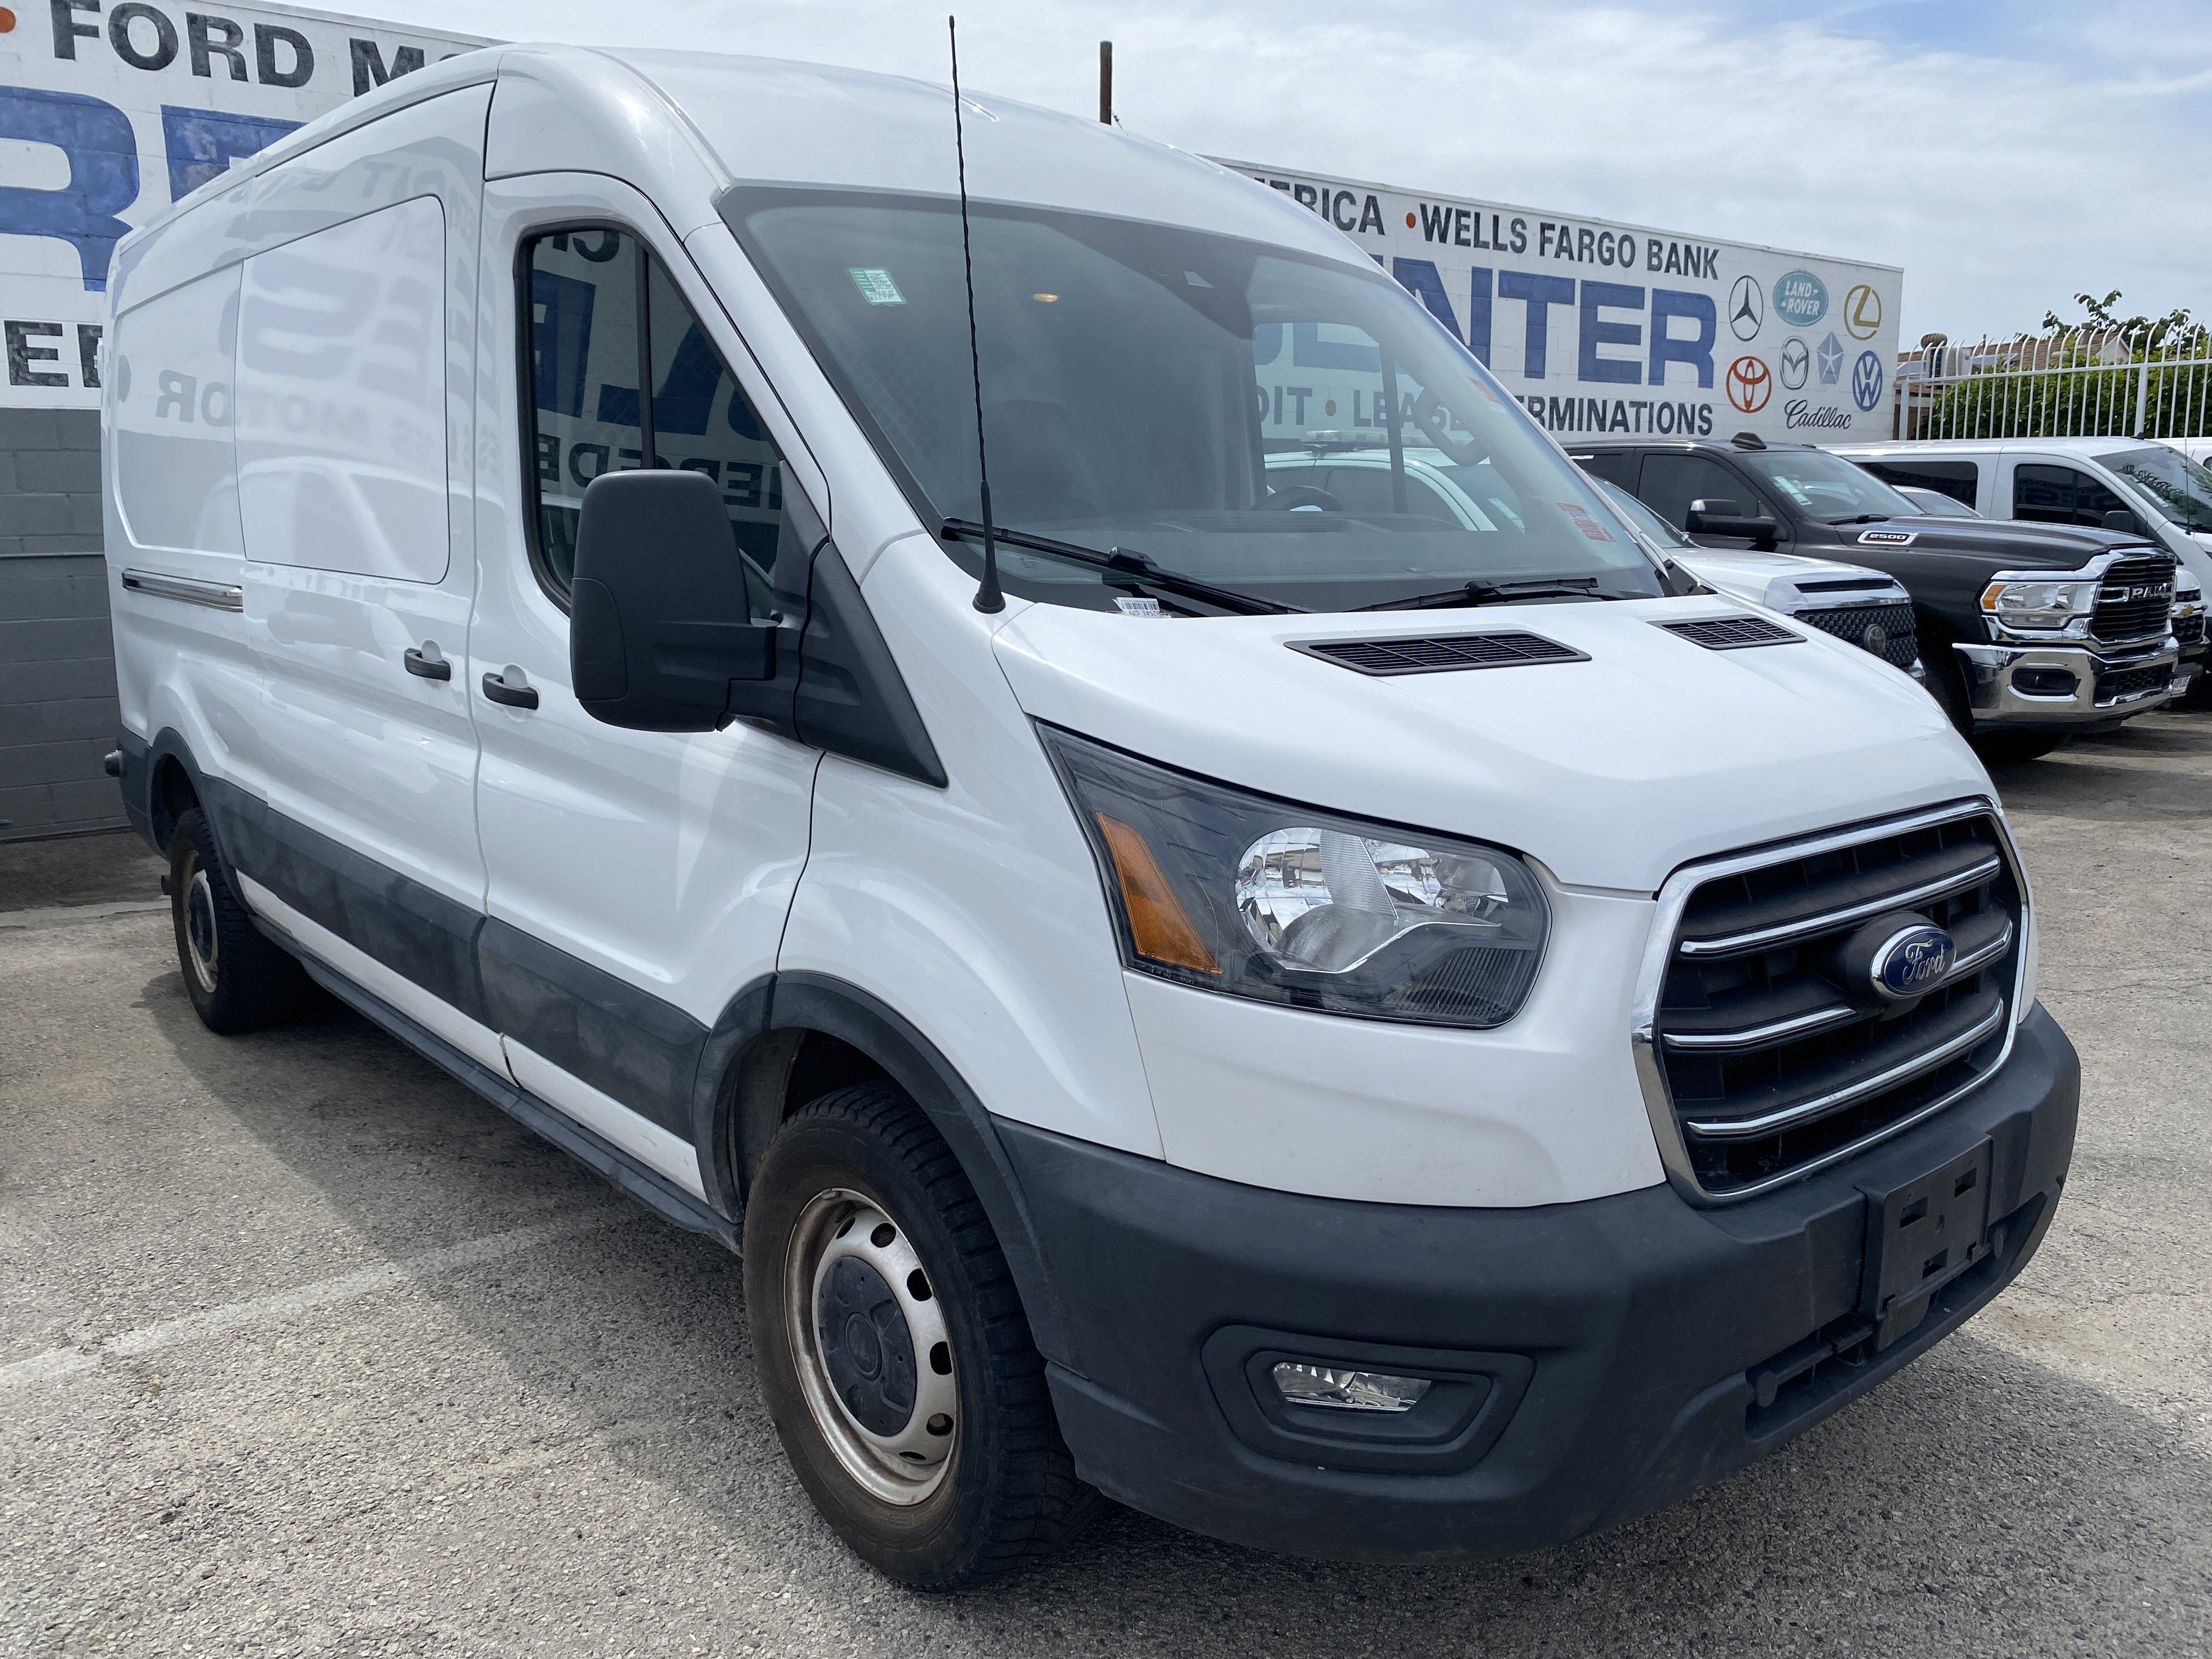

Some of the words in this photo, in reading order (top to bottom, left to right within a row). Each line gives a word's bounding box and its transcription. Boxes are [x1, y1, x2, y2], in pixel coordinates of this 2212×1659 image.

[51, 0, 315, 88] FORD
[1254, 177, 1385, 236] RICA
[1420, 204, 1528, 254] WELLS
[1539, 223, 1636, 268] FARGO
[1647, 238, 1719, 280] BANK
[1514, 395, 1713, 436] RMINATIONS
[1784, 399, 1852, 430] Cadillac
[1902, 939, 1945, 985] Ford
